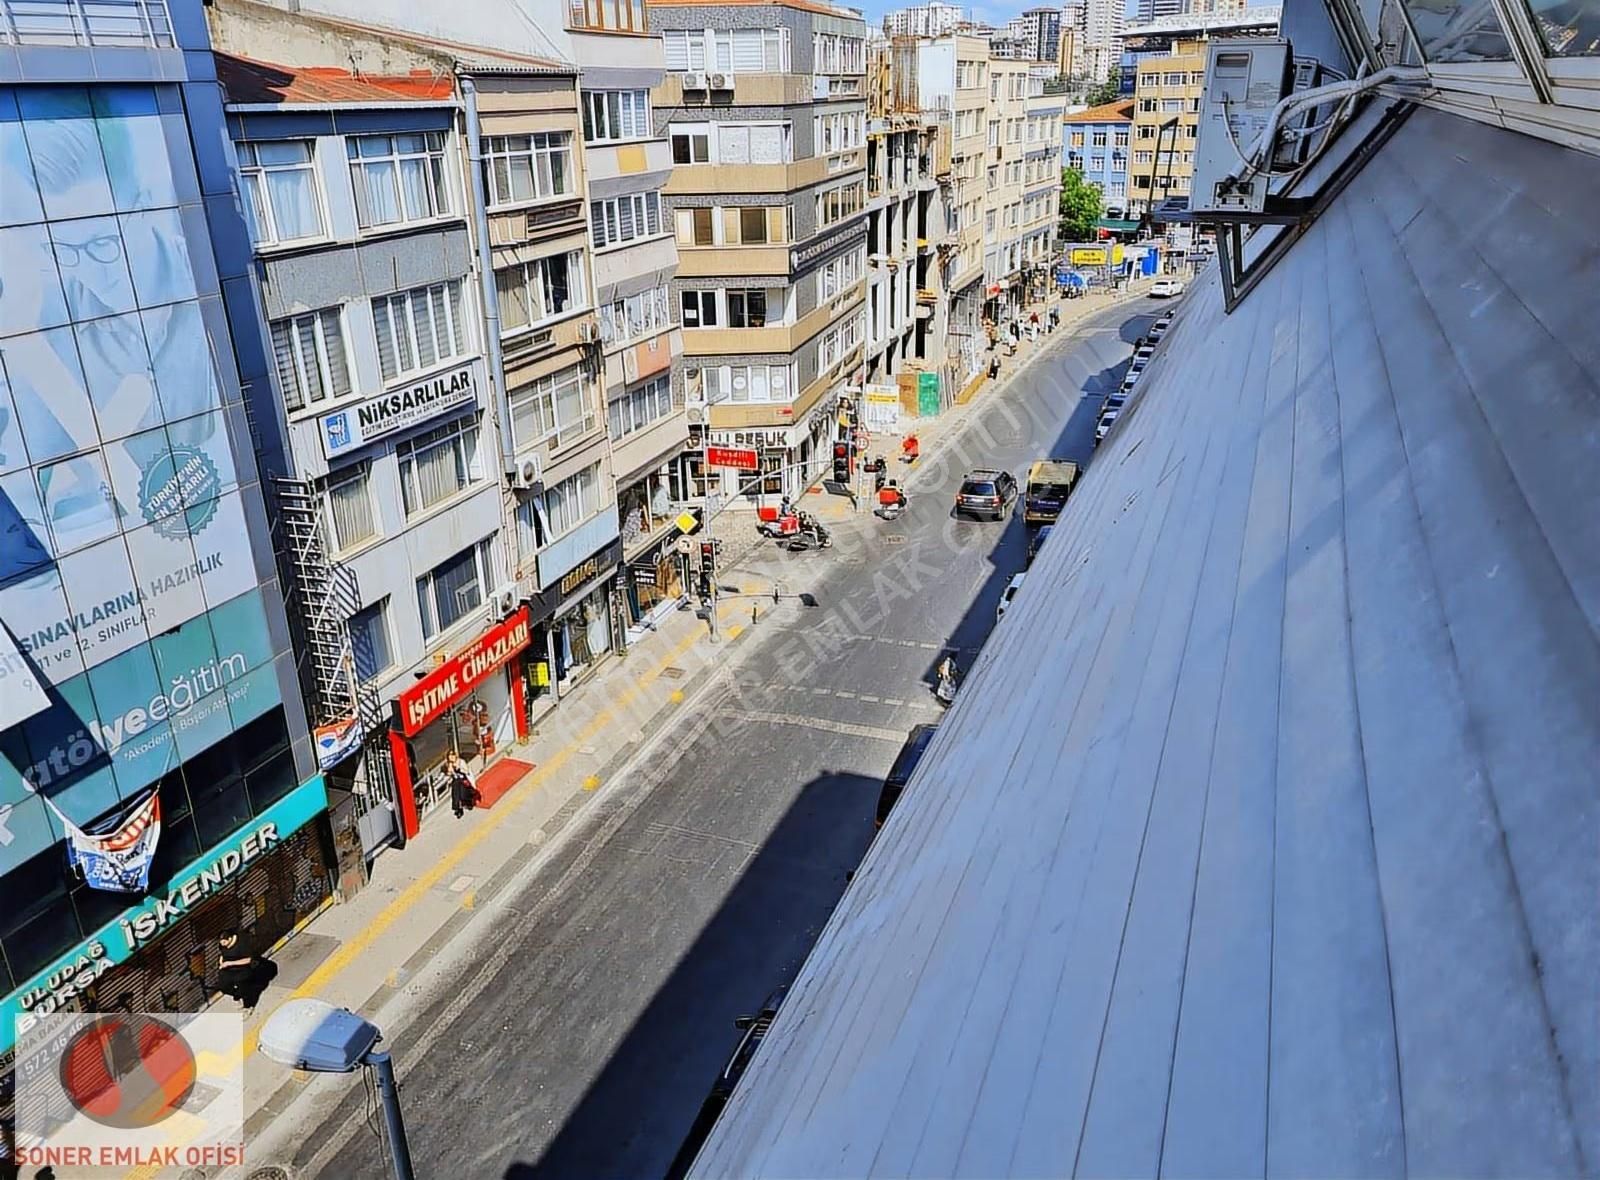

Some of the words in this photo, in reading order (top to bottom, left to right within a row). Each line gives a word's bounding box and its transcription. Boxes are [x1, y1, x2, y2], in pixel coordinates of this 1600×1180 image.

[153, 506, 169, 520] EN
[20, 585, 148, 654] SINAVLARINA
[150, 552, 224, 598] HAZIRLIK
[54, 649, 71, 662] ve
[98, 608, 157, 643] SINIFLAR
[408, 672, 459, 727] İŞİTME
[462, 620, 528, 684] CİHAZLARI
[120, 822, 280, 950] İSKENDER
[17, 957, 117, 1034] BURSA
[20, 940, 106, 1010] ULUDAĞ
[24, 1049, 50, 1076] 572
